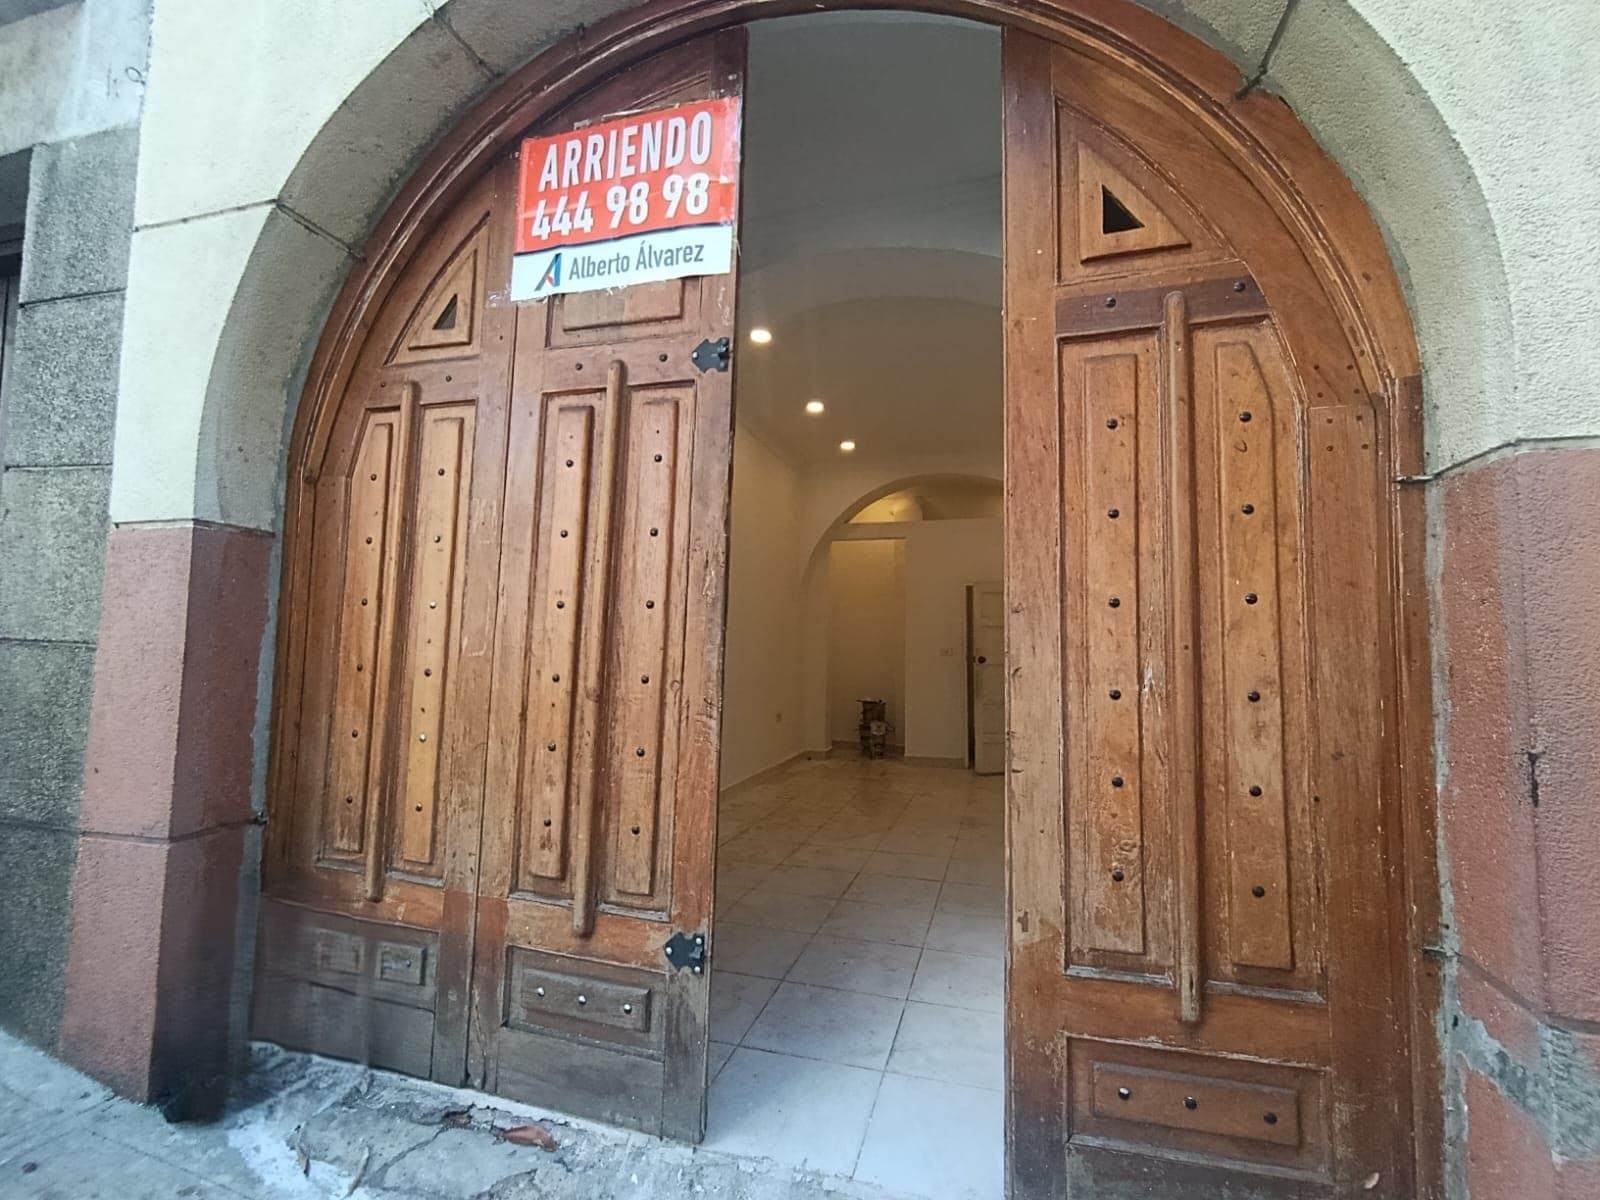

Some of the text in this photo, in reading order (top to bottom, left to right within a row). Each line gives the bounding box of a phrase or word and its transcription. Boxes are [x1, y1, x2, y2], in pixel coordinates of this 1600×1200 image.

[538, 111, 712, 192] ARRIENDO
[531, 172, 710, 241] 444 98 98
[568, 240, 705, 281] Alberto Álvarez
